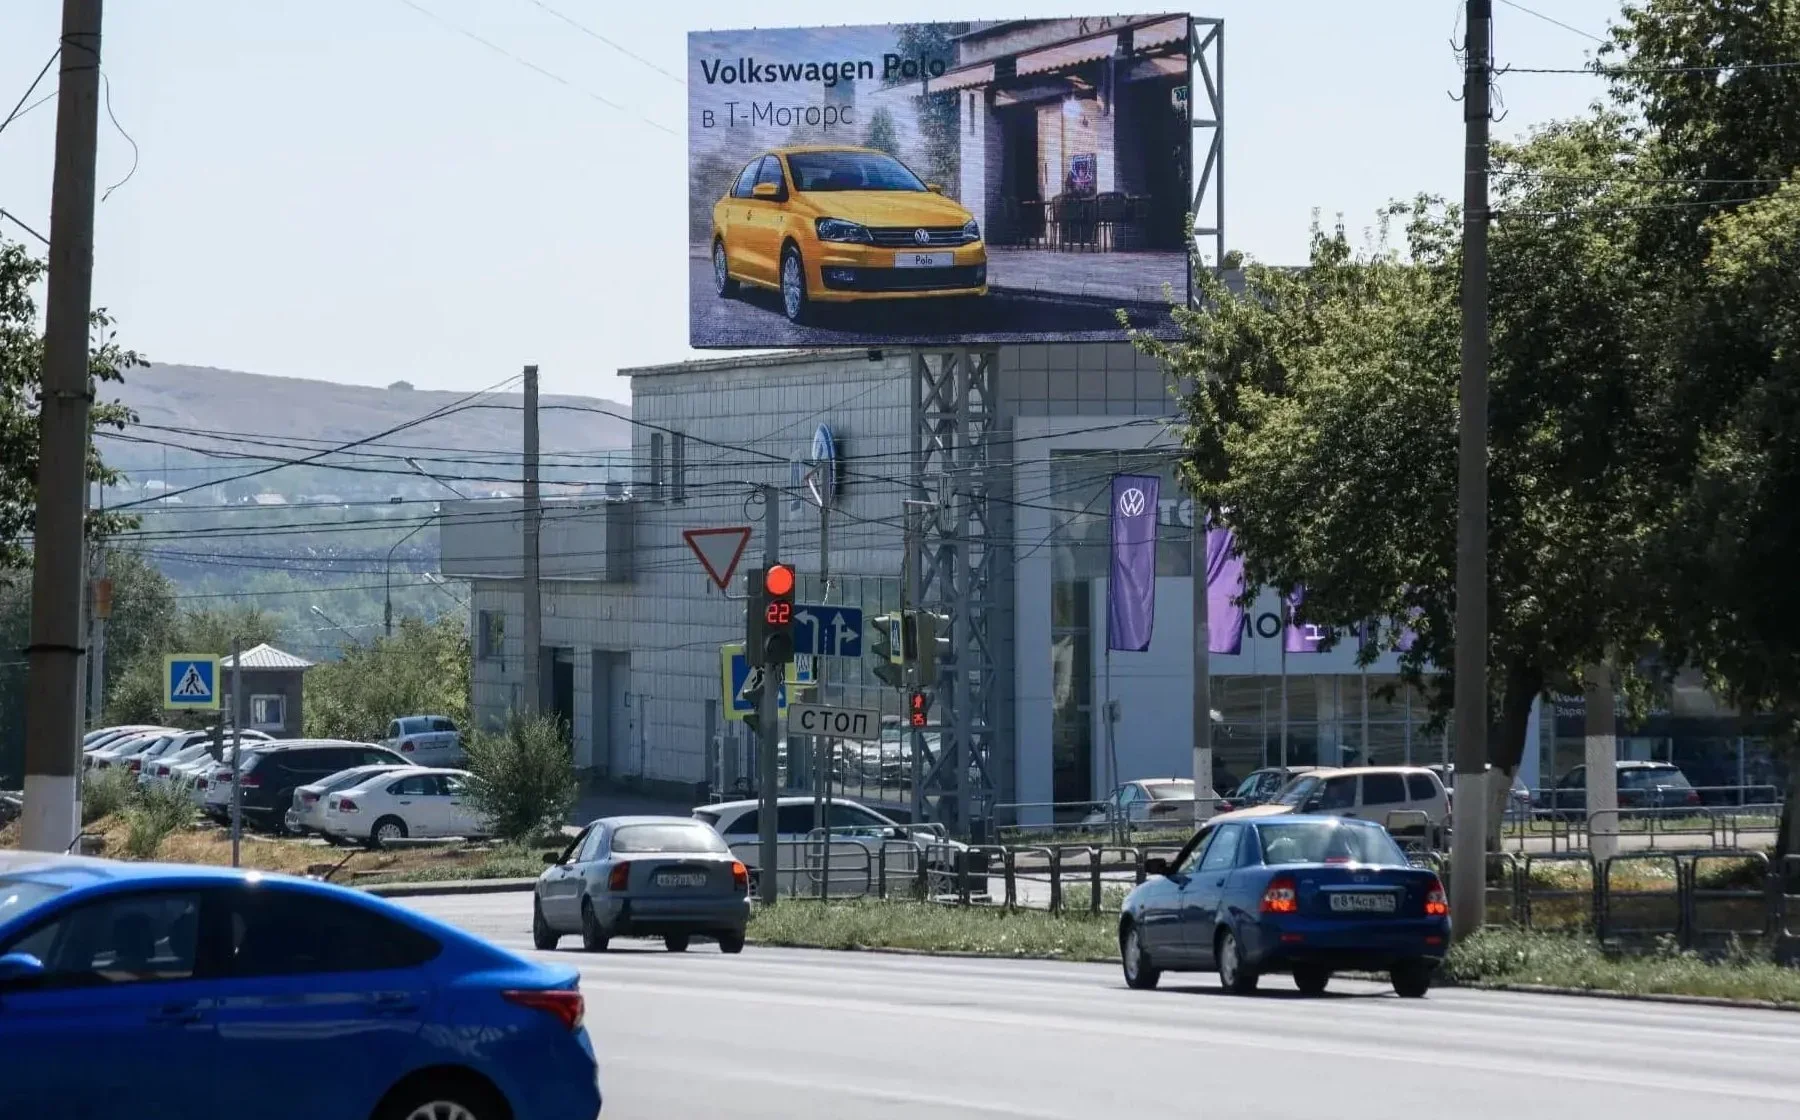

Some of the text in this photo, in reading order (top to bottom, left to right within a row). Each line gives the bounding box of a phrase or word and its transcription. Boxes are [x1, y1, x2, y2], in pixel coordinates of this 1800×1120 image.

[701, 53, 945, 87] Volkswagen Polo
[702, 101, 853, 132] в Т-Моторс
[915, 254, 933, 265] Polo
[767, 603, 789, 623] 22
[801, 711, 868, 734] СТОП
